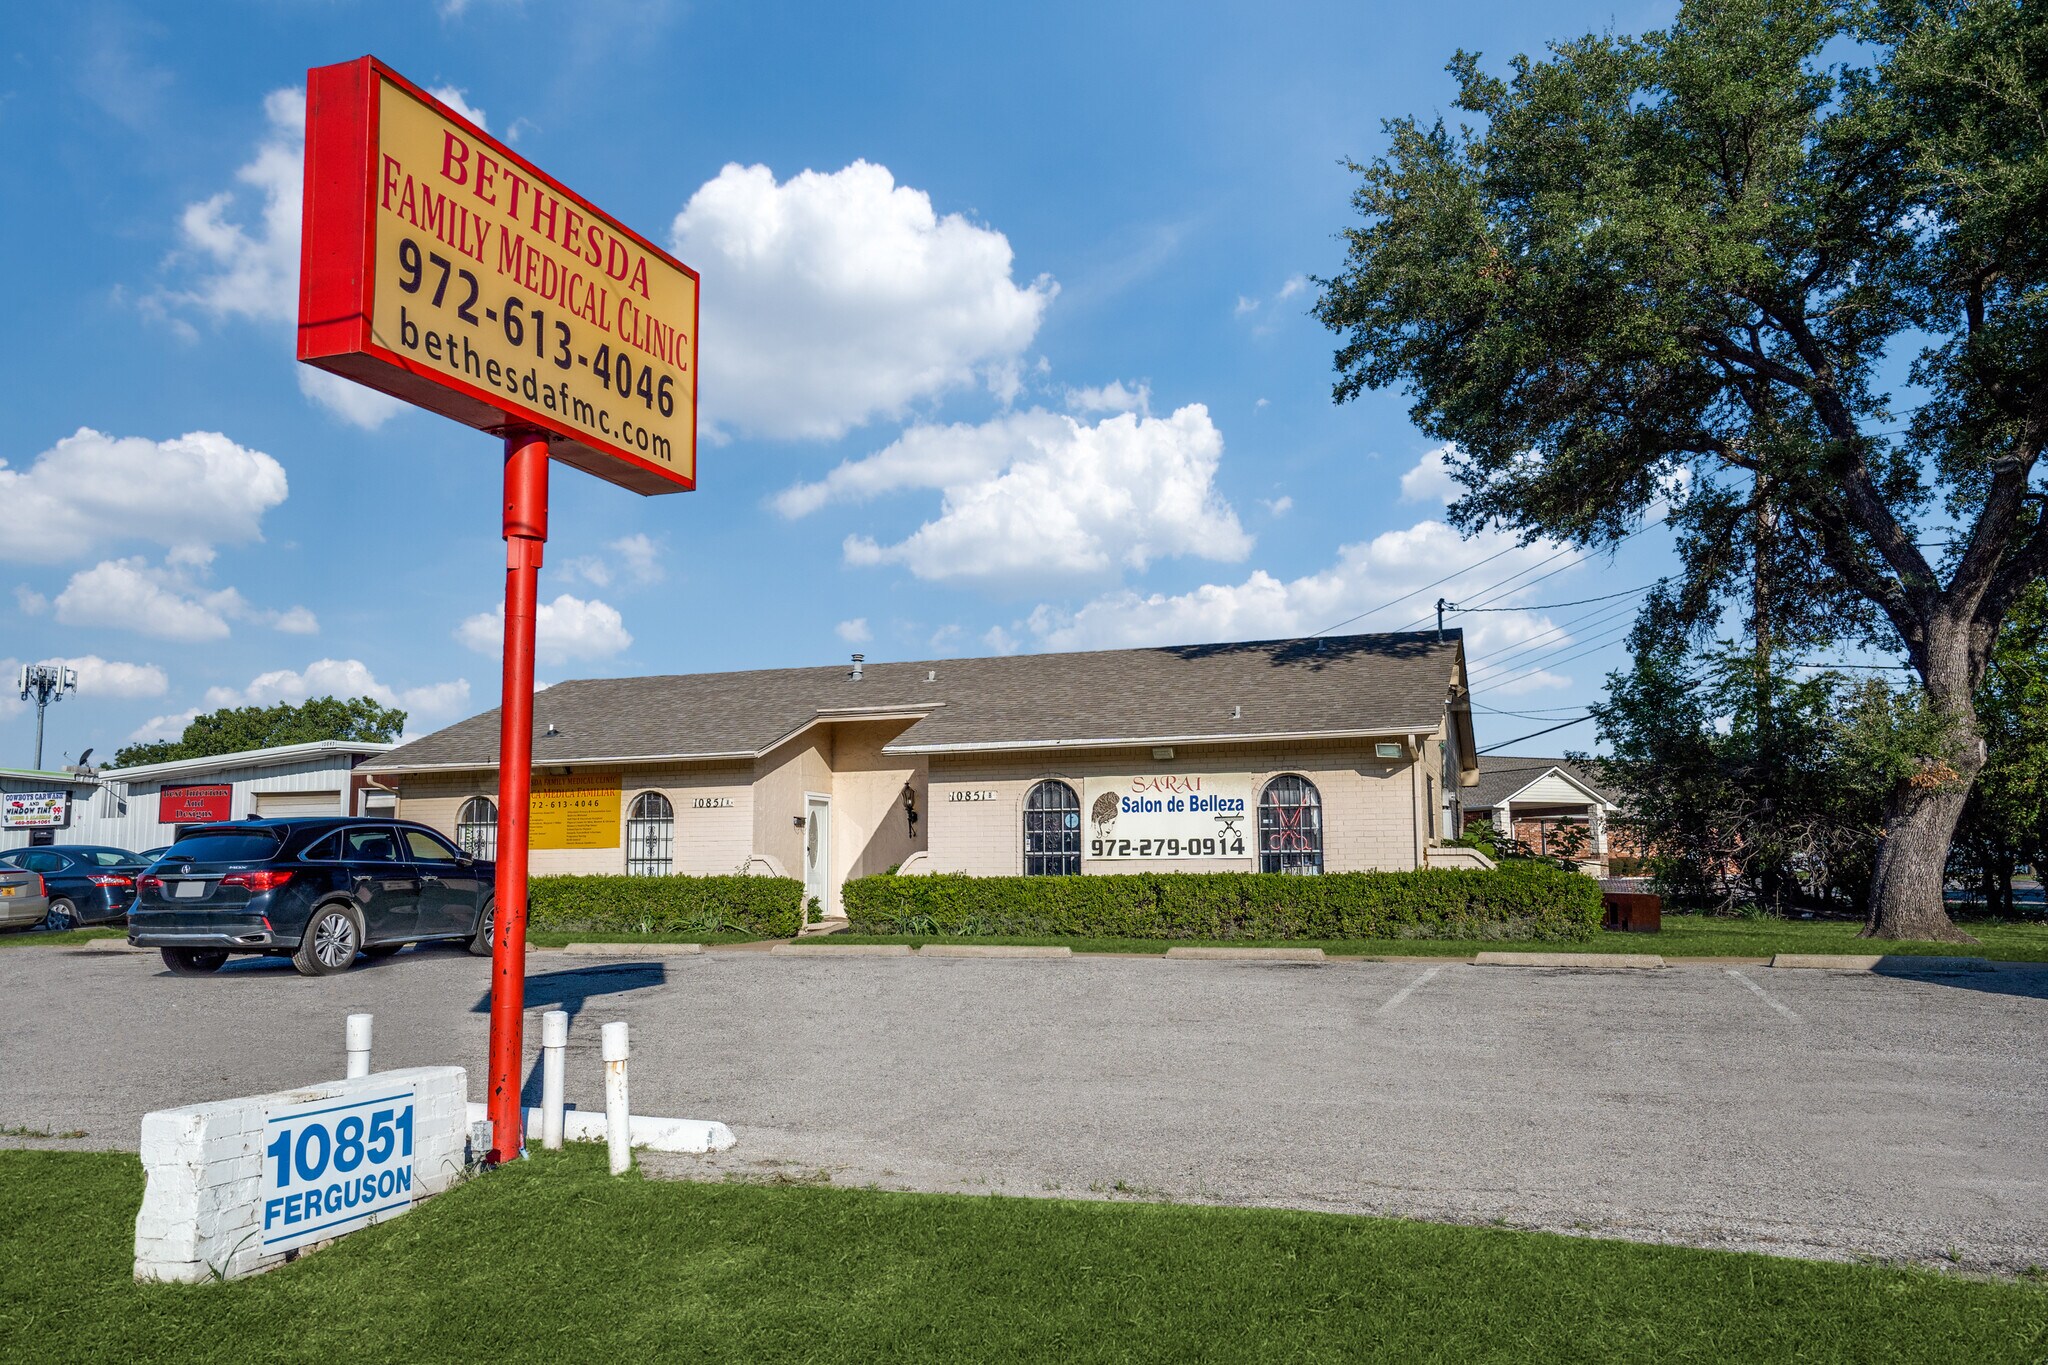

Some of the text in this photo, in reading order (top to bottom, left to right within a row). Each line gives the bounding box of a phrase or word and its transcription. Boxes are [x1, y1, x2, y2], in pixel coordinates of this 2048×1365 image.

[440, 129, 650, 300] BETHESDA
[381, 153, 688, 372] FAMILY MEDICAL CLINIC
[399, 238, 674, 417] 972-613-4046
[400, 306, 672, 461] bethesdafmc.com
[544, 778, 565, 786] FAMILY
[567, 776, 594, 786] MEDICAL
[595, 775, 617, 784] CLINIC
[1131, 775, 1201, 794] SARAI
[186, 788, 228, 797] Interiors
[543, 788, 575, 799] MEDICA
[577, 787, 616, 798] FAMILIAR
[950, 790, 985, 801] 10851
[184, 799, 204, 807] And
[532, 800, 599, 809] 72-613-4046
[693, 797, 724, 808] 10851
[1121, 794, 1244, 813] Salon de Belleza
[6, 806, 51, 815] WINDOW TINT
[175, 808, 212, 819] Designs
[1091, 837, 1245, 857] 972-279-0914
[267, 1104, 413, 1189] 10851
[264, 1164, 411, 1231] FERGUSON
